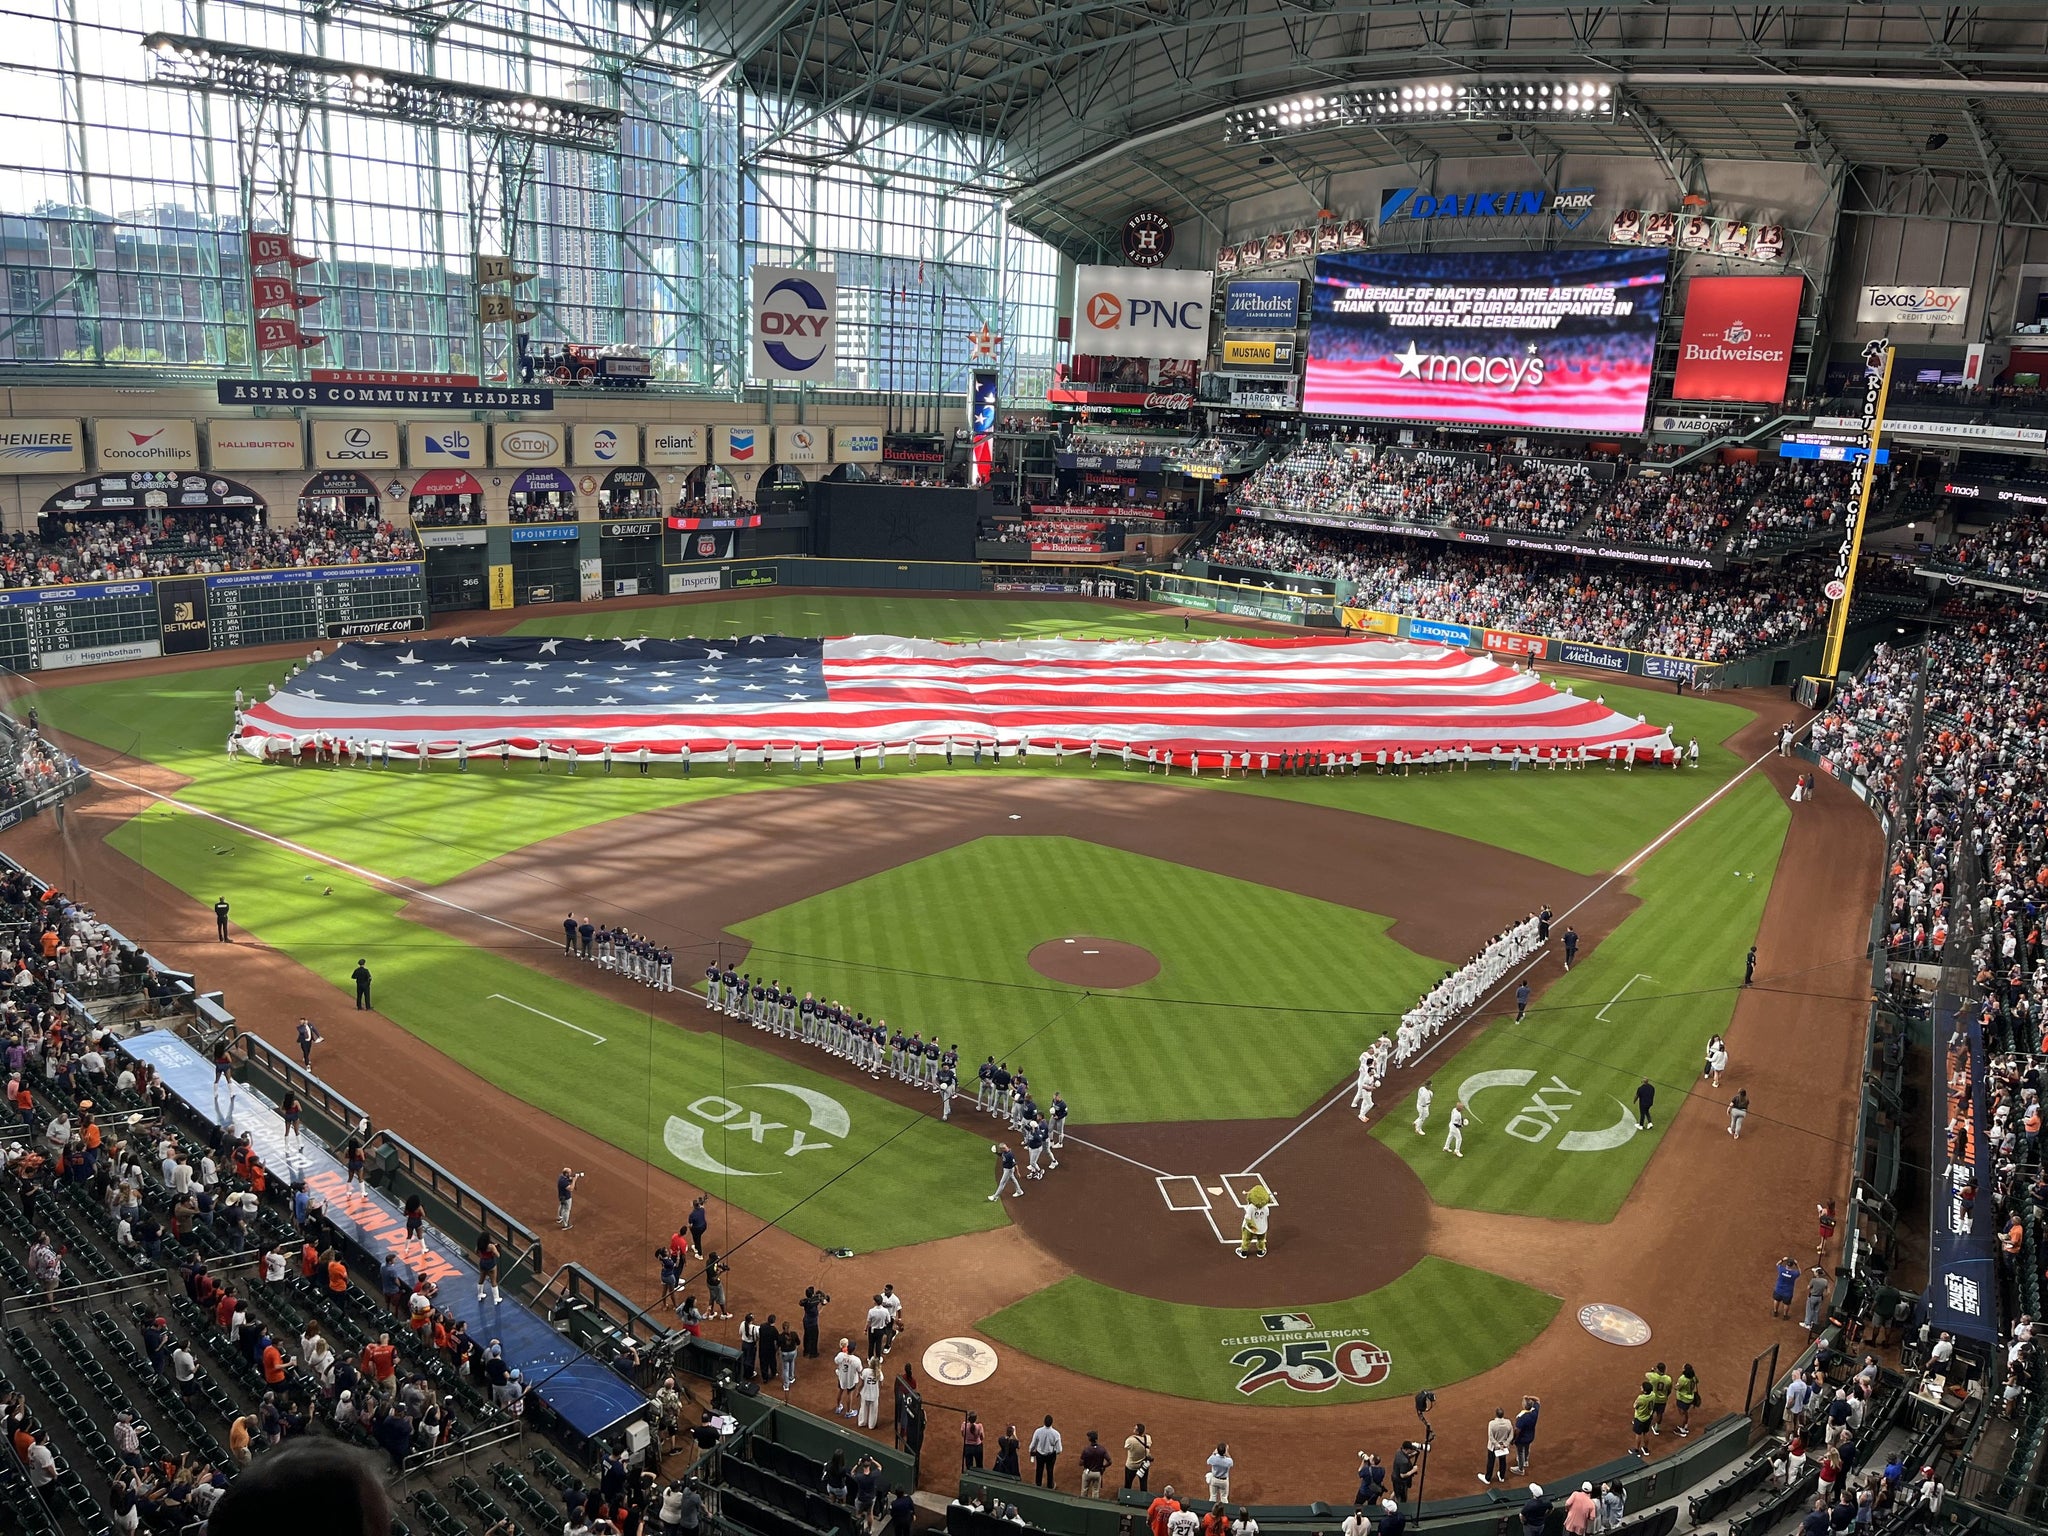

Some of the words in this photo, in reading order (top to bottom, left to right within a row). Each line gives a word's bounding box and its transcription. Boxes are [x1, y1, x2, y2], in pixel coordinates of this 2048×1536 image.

[1411, 190, 1546, 218] DAIKIN
[1552, 194, 1595, 207] PARK
[1129, 213, 1169, 230] HOUSTON
[1614, 210, 1638, 228] 49
[1648, 213, 1673, 231] 24
[1690, 217, 1703, 235] 5
[1727, 222, 1740, 240] 7
[1758, 226, 1781, 244] 13
[1138, 230, 1157, 249] H
[258, 240, 282, 256] 05
[1129, 250, 1165, 263] ASTROS
[487, 262, 504, 276] 17
[263, 285, 285, 299] 19
[1345, 288, 1363, 300] ON
[1364, 288, 1415, 300] BEHALF
[1415, 288, 1434, 300] OF
[1434, 288, 1486, 300] MACY'S
[1486, 288, 1518, 300] AND
[1519, 288, 1549, 300] THE
[1549, 288, 1617, 302] ASTROS,
[1231, 296, 1292, 311] Methodist
[1333, 300, 1375, 312] THANK
[1378, 301, 1405, 313] YOU
[1406, 301, 1425, 313] TO
[1425, 301, 1451, 313] ALL
[1452, 301, 1473, 313] OF
[1473, 302, 1504, 314] OUR
[1504, 302, 1615, 315] PARTICIPANTS
[1615, 302, 1633, 315] IN
[1868, 289, 1916, 307] Texas
[1924, 290, 1960, 312] Bay
[487, 303, 505, 315] 22
[1127, 299, 1203, 329] PNC
[1389, 314, 1445, 327] TODAY'S
[1445, 315, 1482, 327] FLAG
[1482, 315, 1562, 329] CEREMONY
[1896, 313, 1924, 321] CREDIT
[760, 312, 829, 337] OXY
[265, 325, 286, 339] 21
[1232, 348, 1271, 358] MUSTANG
[1276, 348, 1291, 359] CAT
[1684, 344, 1783, 361] Budweiser
[333, 373, 397, 382] DAIKIN
[412, 376, 452, 384] PARK
[235, 386, 317, 399] ASTROS
[328, 389, 453, 403] COMMUNITY
[463, 392, 541, 405] LEADERS
[1241, 393, 1288, 407] HARGROVE
[1862, 376, 1880, 429] ROOT
[443, 431, 470, 448] slb
[509, 438, 550, 453] COTTON
[655, 435, 693, 448] reliant
[851, 437, 878, 451] LNG
[1857, 435, 1868, 449] 4
[104, 448, 191, 460] ConocoPhillips
[326, 451, 389, 460] LEXUS
[884, 448, 944, 462] Budweiser
[1416, 452, 1456, 468] Chevy
[1181, 465, 1223, 474] PLUCKERS
[526, 473, 554, 483] planet
[614, 472, 632, 482] SPACE
[632, 472, 646, 482] CITY
[1085, 473, 1138, 484] Budweiser
[131, 481, 179, 489] LANDRY'S
[529, 481, 559, 489] fitness
[2013, 494, 2048, 505] Fireworks.
[1055, 506, 1095, 515] Budweiser
[1118, 508, 1154, 517] Budweiser
[515, 529, 575, 539] 1POINTFIVE
[621, 525, 651, 534] EMCJET
[1348, 521, 1388, 532] Celebrations
[1413, 528, 1439, 538] Macy's.
[1834, 500, 1857, 578] CHIKIN
[1052, 544, 1092, 552] Budweiser
[1520, 541, 1553, 550] Fireworks.
[1572, 546, 1597, 555] Parade.
[1599, 548, 1648, 561] Celebrations
[1650, 555, 1669, 563] start
[1681, 557, 1712, 568] Macy's.
[582, 572, 599, 580] WM
[681, 575, 719, 587] Insperity
[40, 590, 76, 599] GEICO
[105, 584, 140, 593] GEICO
[316, 585, 325, 636] AMERICAN
[1232, 605, 1250, 615] SPACE
[1250, 607, 1261, 617] CITY
[164, 620, 206, 632] BETMGM
[341, 620, 411, 635] NITTOTIRE.COM
[1422, 626, 1469, 640] HONDA
[27, 609, 38, 667] NATIONAL
[81, 647, 141, 660] Higginbotham
[1565, 645, 1589, 653] HOUSTON
[1565, 650, 1622, 668] Methodist
[1505, 1075, 1582, 1142] OXY
[687, 1095, 833, 1157] OXY
[303, 1171, 397, 1232] DAIKIN
[374, 1227, 463, 1283] PARK
[1221, 1333, 1303, 1346] CELEBRATING
[1304, 1328, 1370, 1339] AMERICA'S
[1229, 1340, 1391, 1396] 250
[1361, 1352, 1390, 1364] TH
[1177, 1526, 1190, 1536] 27
